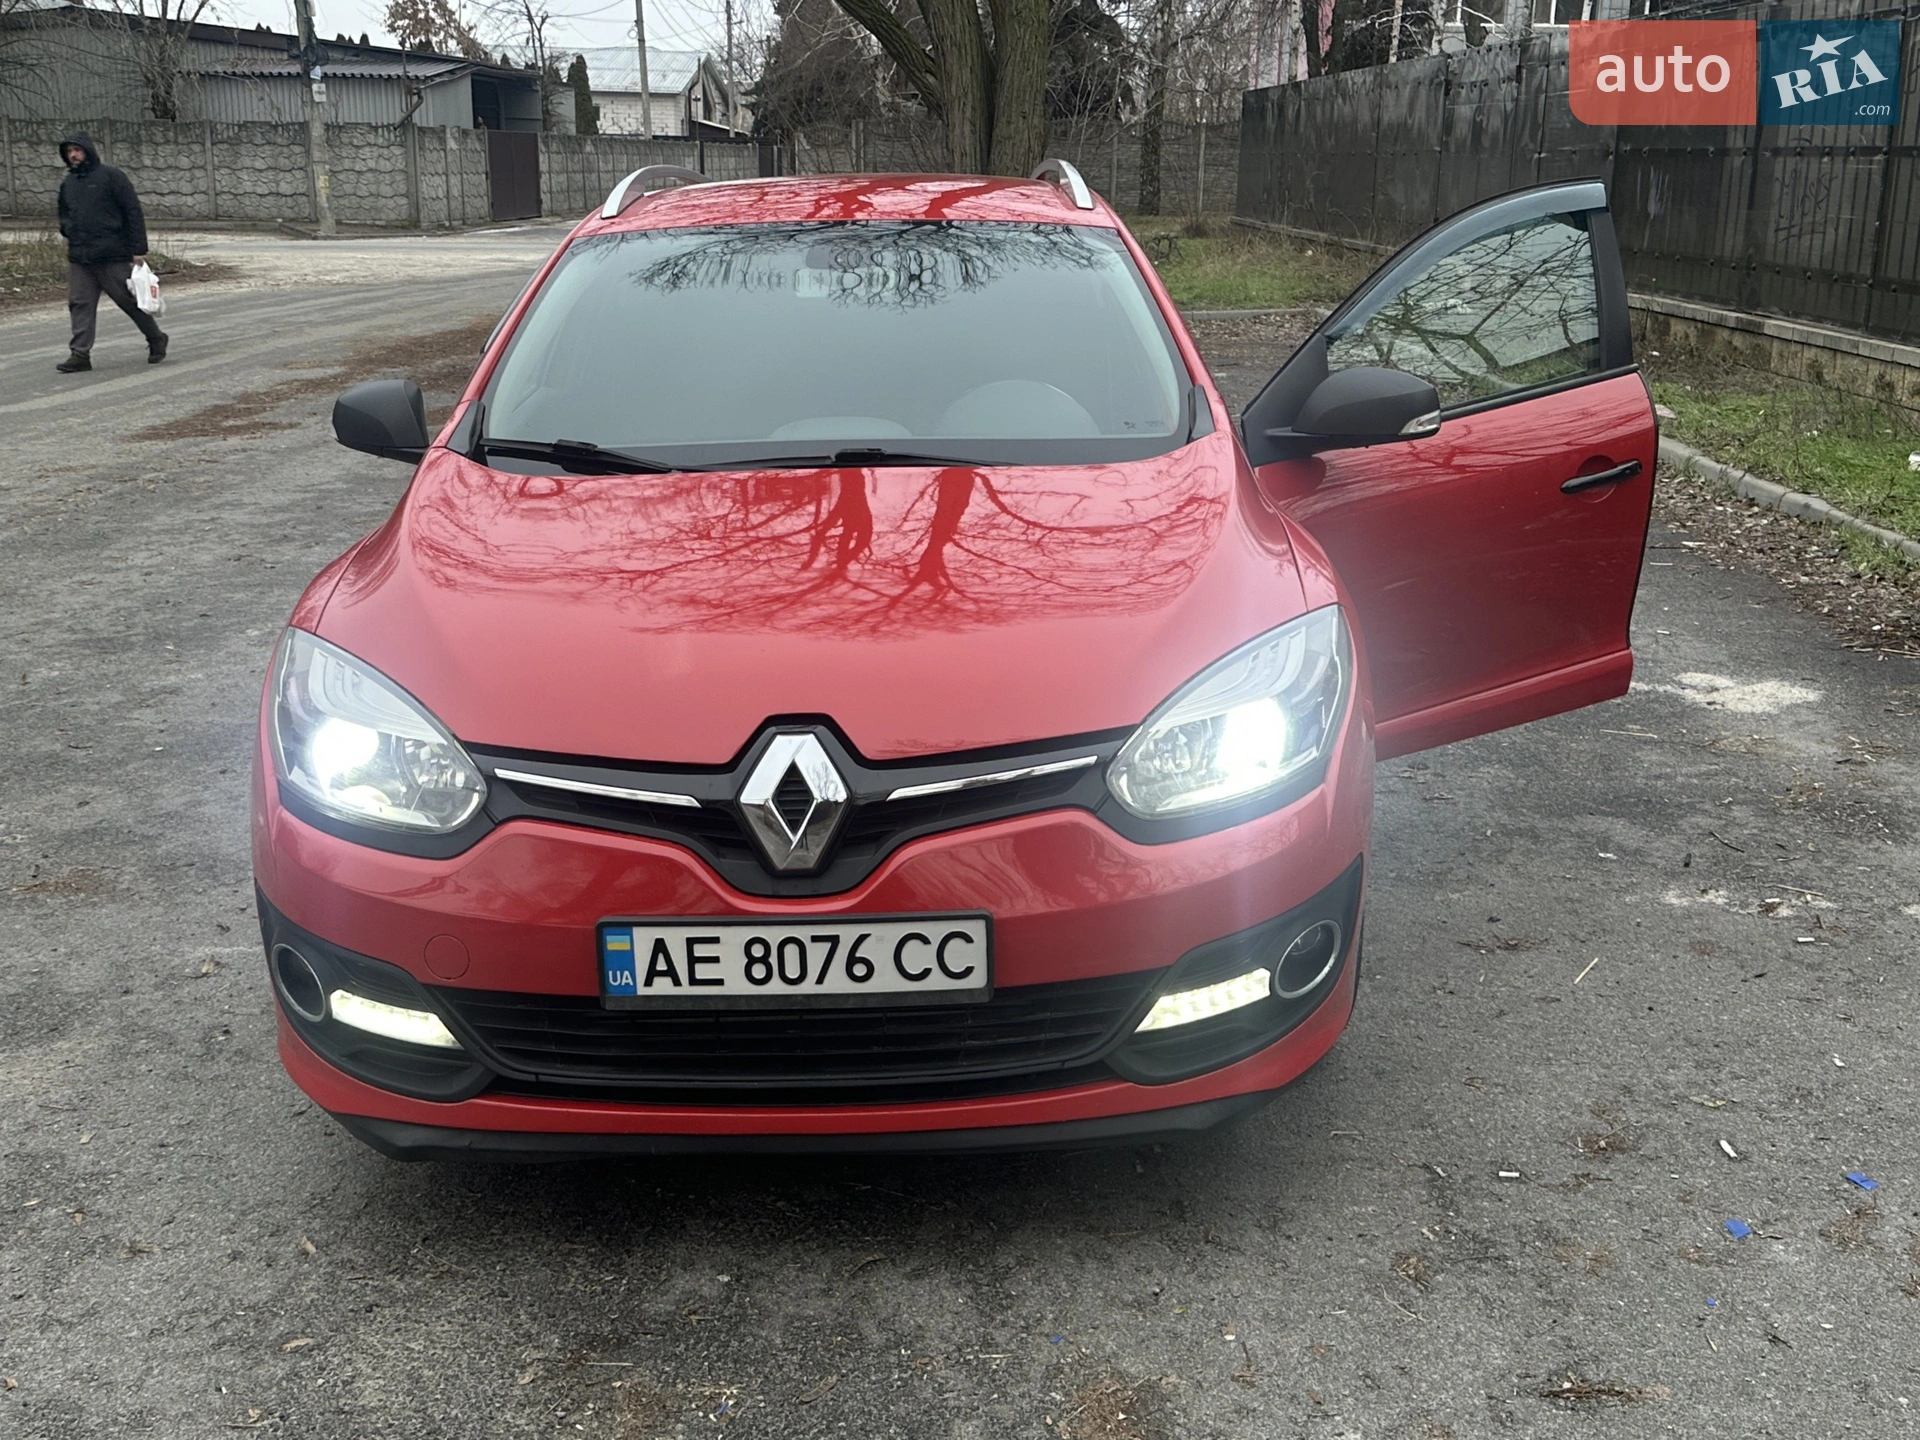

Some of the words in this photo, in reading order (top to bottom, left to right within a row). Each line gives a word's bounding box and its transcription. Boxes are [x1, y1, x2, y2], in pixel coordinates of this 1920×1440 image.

[643, 935, 725, 988] AE
[743, 933, 875, 986] 8076
[892, 930, 975, 982] CC
[608, 970, 634, 986] UA
